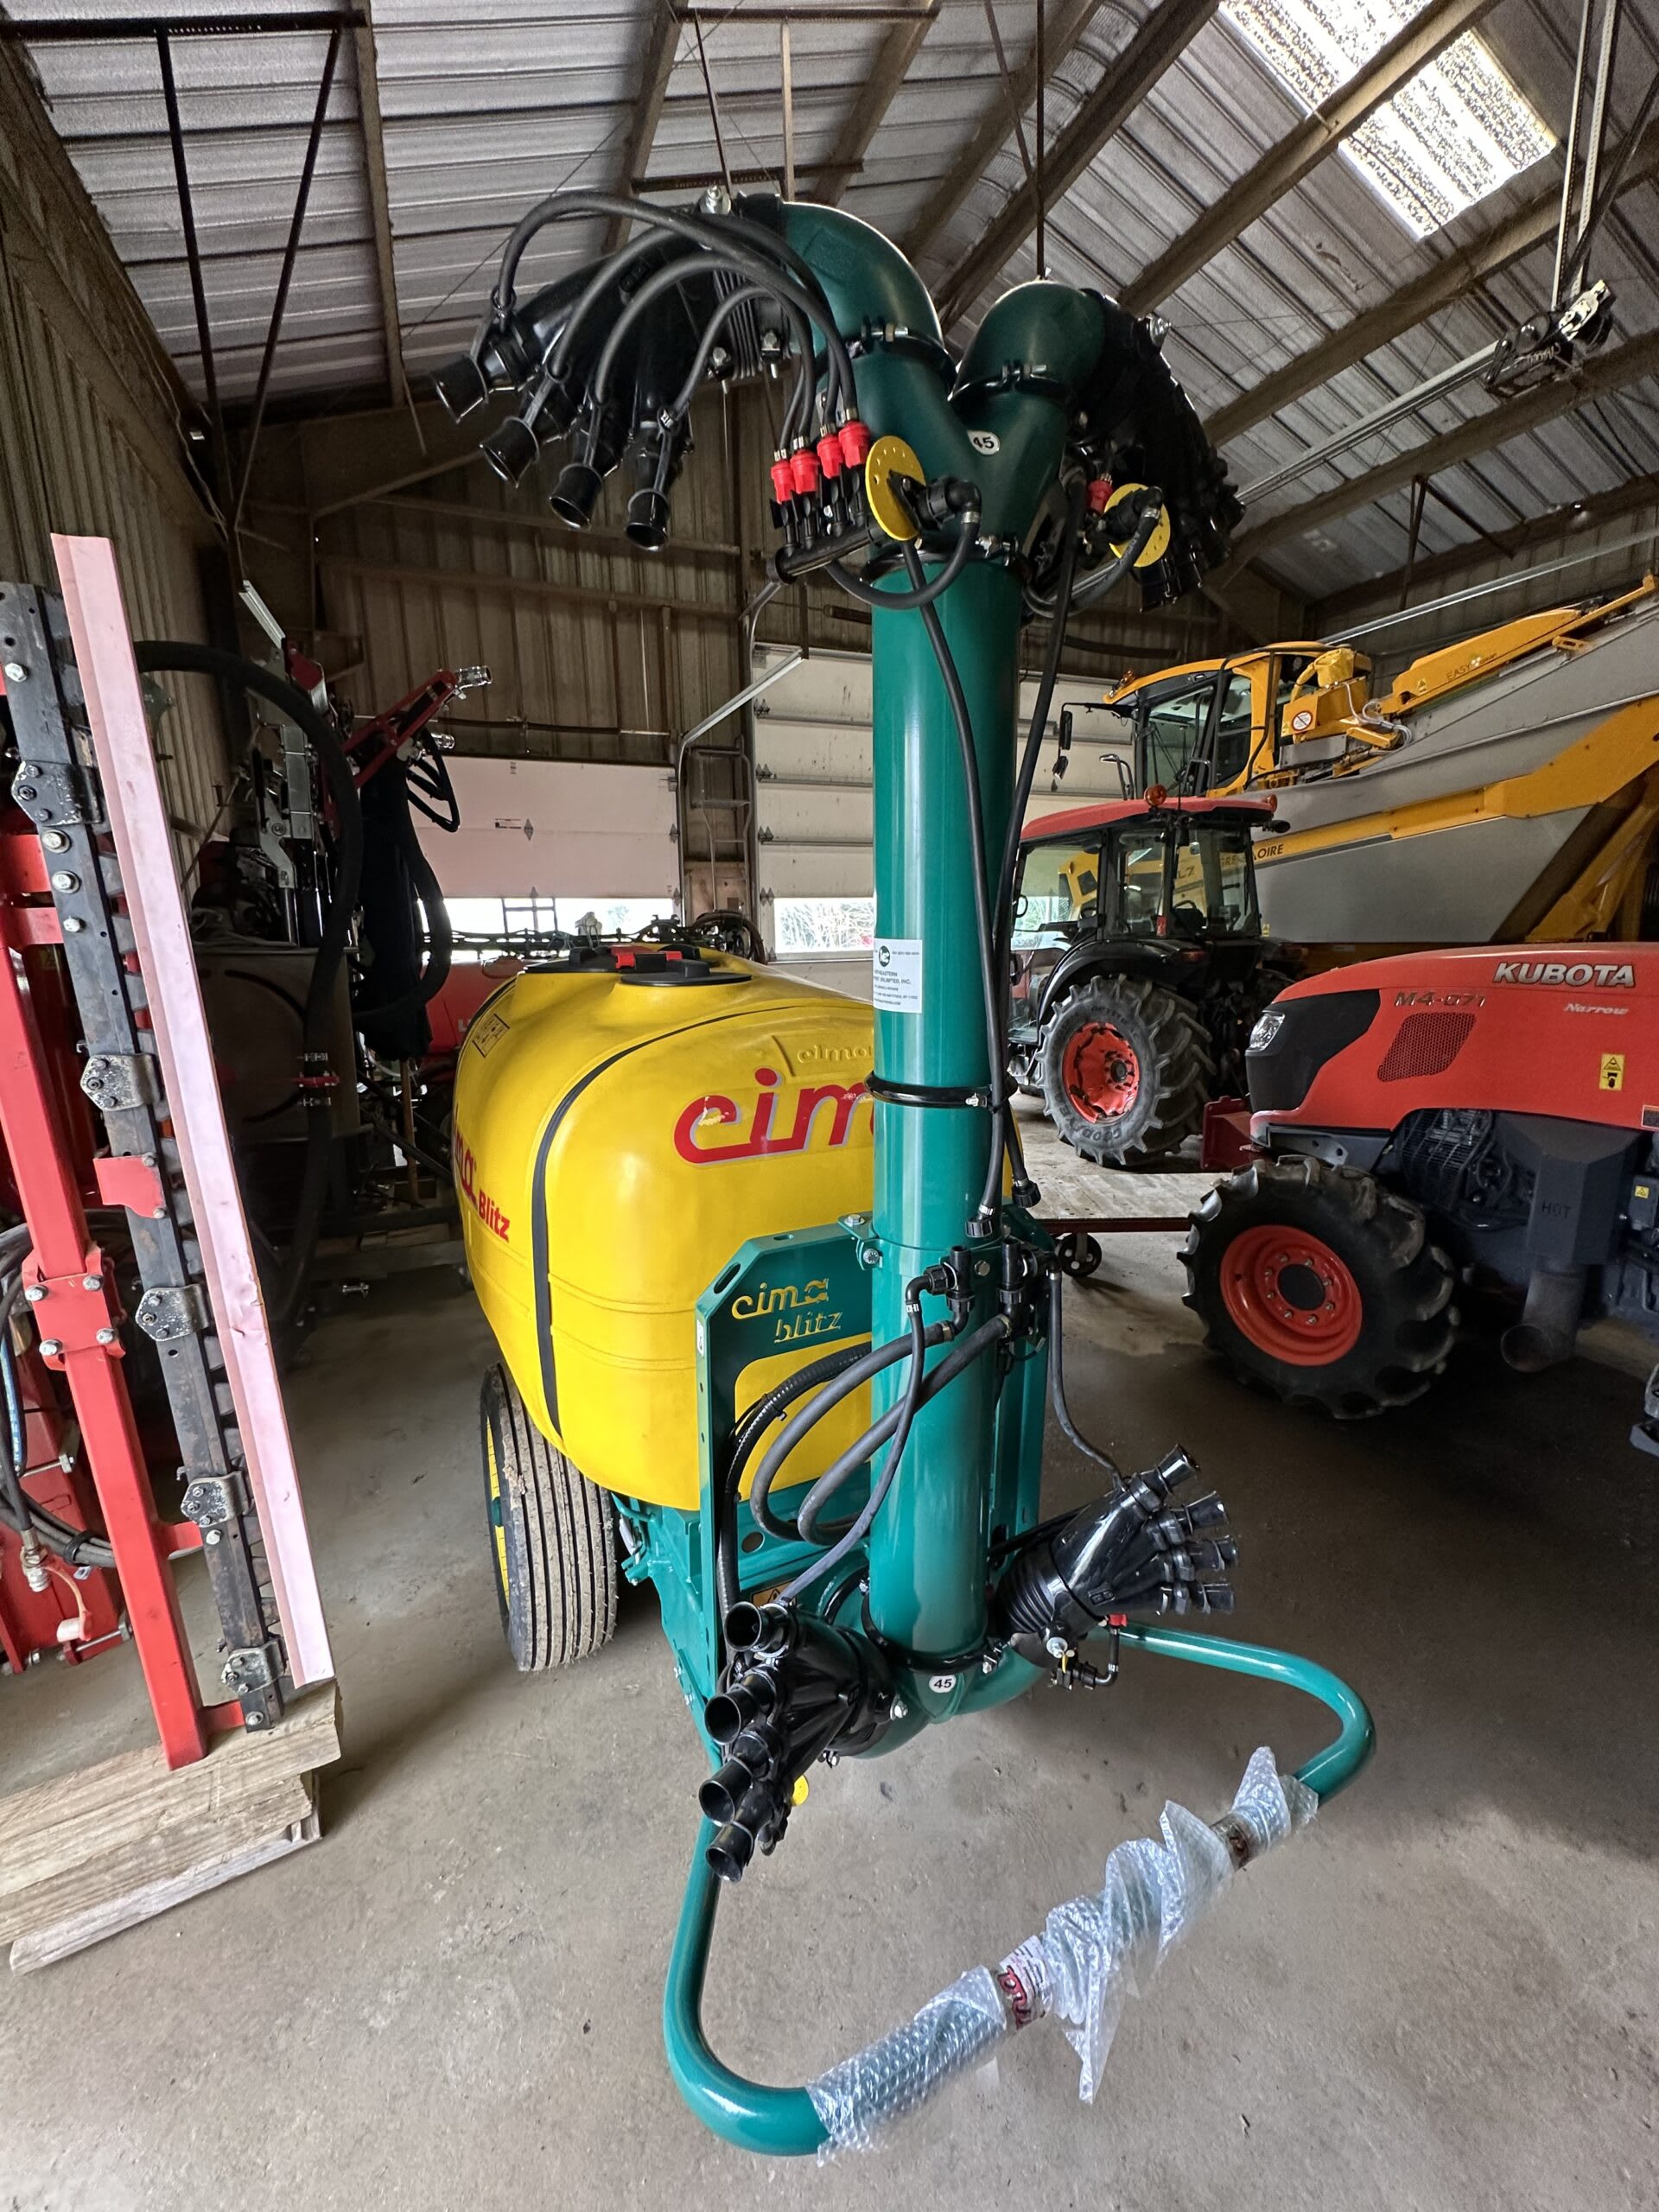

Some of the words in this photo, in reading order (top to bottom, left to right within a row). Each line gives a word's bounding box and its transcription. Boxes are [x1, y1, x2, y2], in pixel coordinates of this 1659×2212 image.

[973, 436, 995, 449] 45
[1493, 962, 1636, 988] KUBOTA
[1394, 991, 1486, 1008] M4-071
[1563, 1002, 1629, 1016] Narrow
[674, 1067, 874, 1165] cim
[478, 1188, 512, 1243] Blitz
[1541, 1202, 1573, 1219] HOT
[731, 1277, 830, 1320] cima
[773, 1311, 843, 1344] blitz
[933, 1678, 953, 1689] 45
